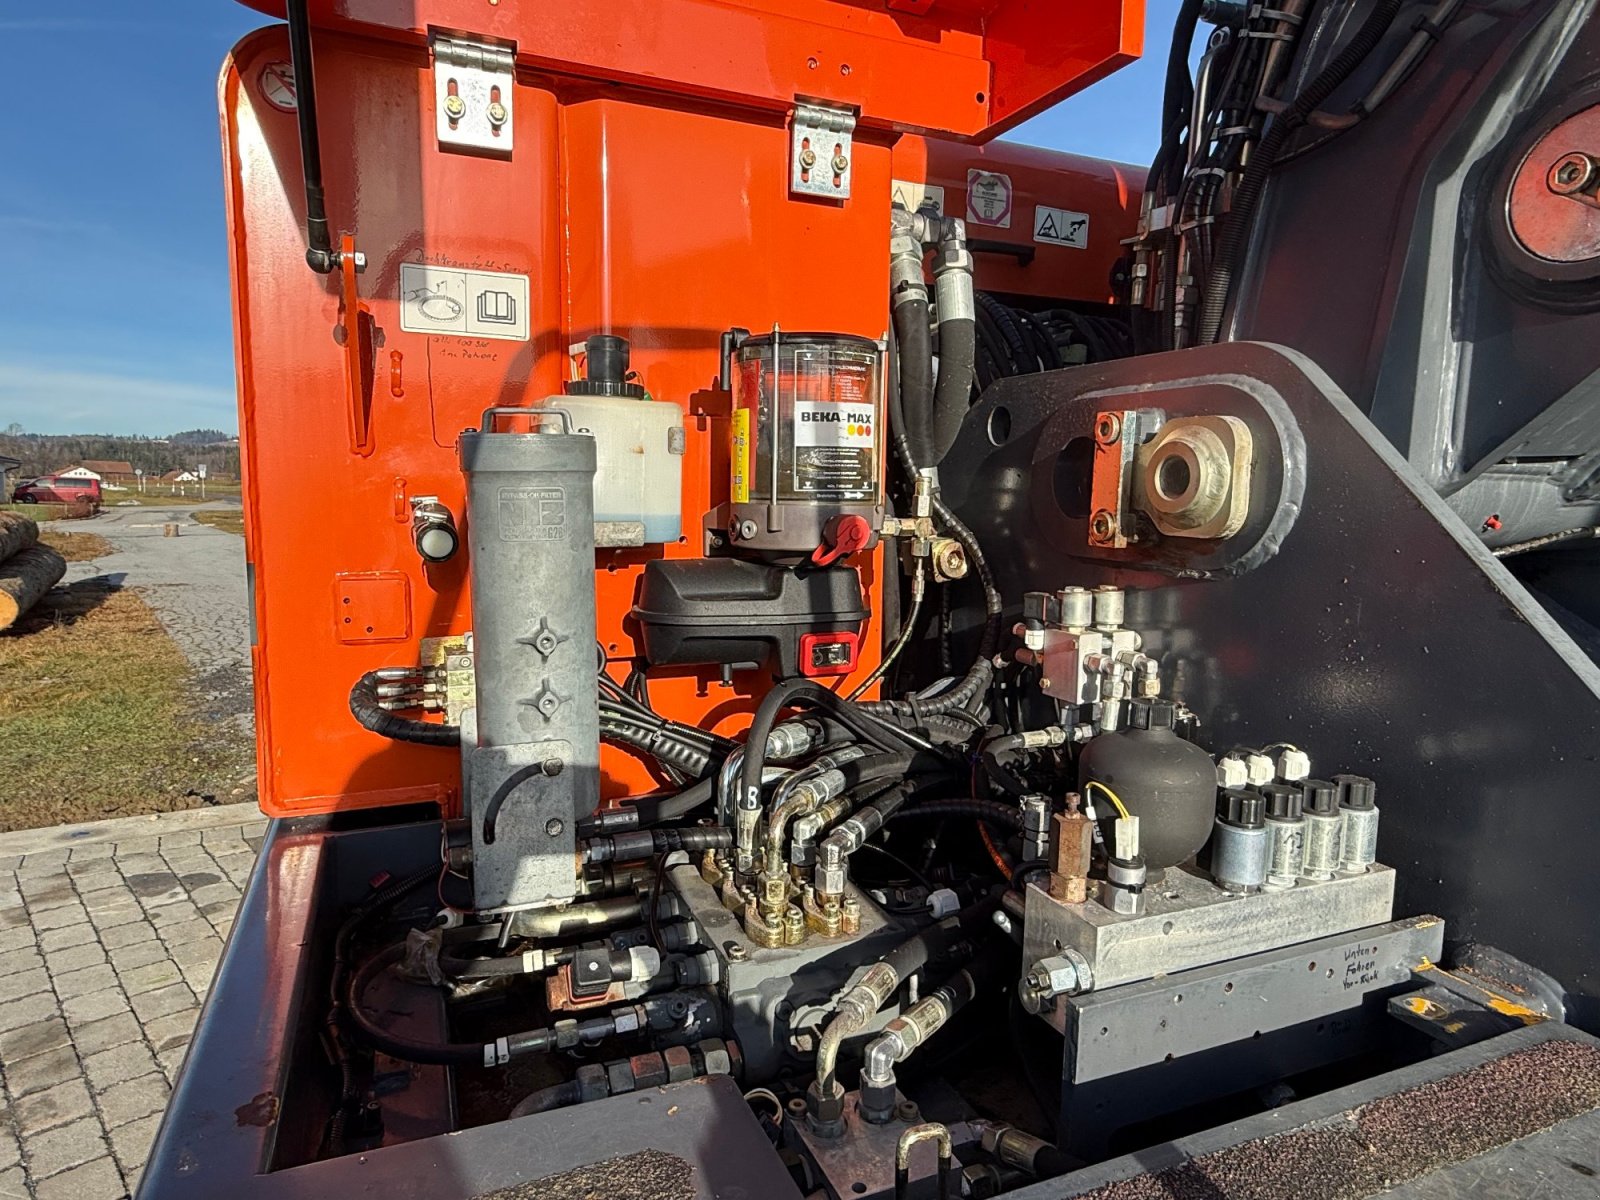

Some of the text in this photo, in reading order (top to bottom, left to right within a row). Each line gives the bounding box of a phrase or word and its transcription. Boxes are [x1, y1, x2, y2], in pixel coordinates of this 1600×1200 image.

[747, 785, 759, 810] B
[1344, 943, 1370, 961] Unten
[1346, 960, 1375, 976] Fahren
